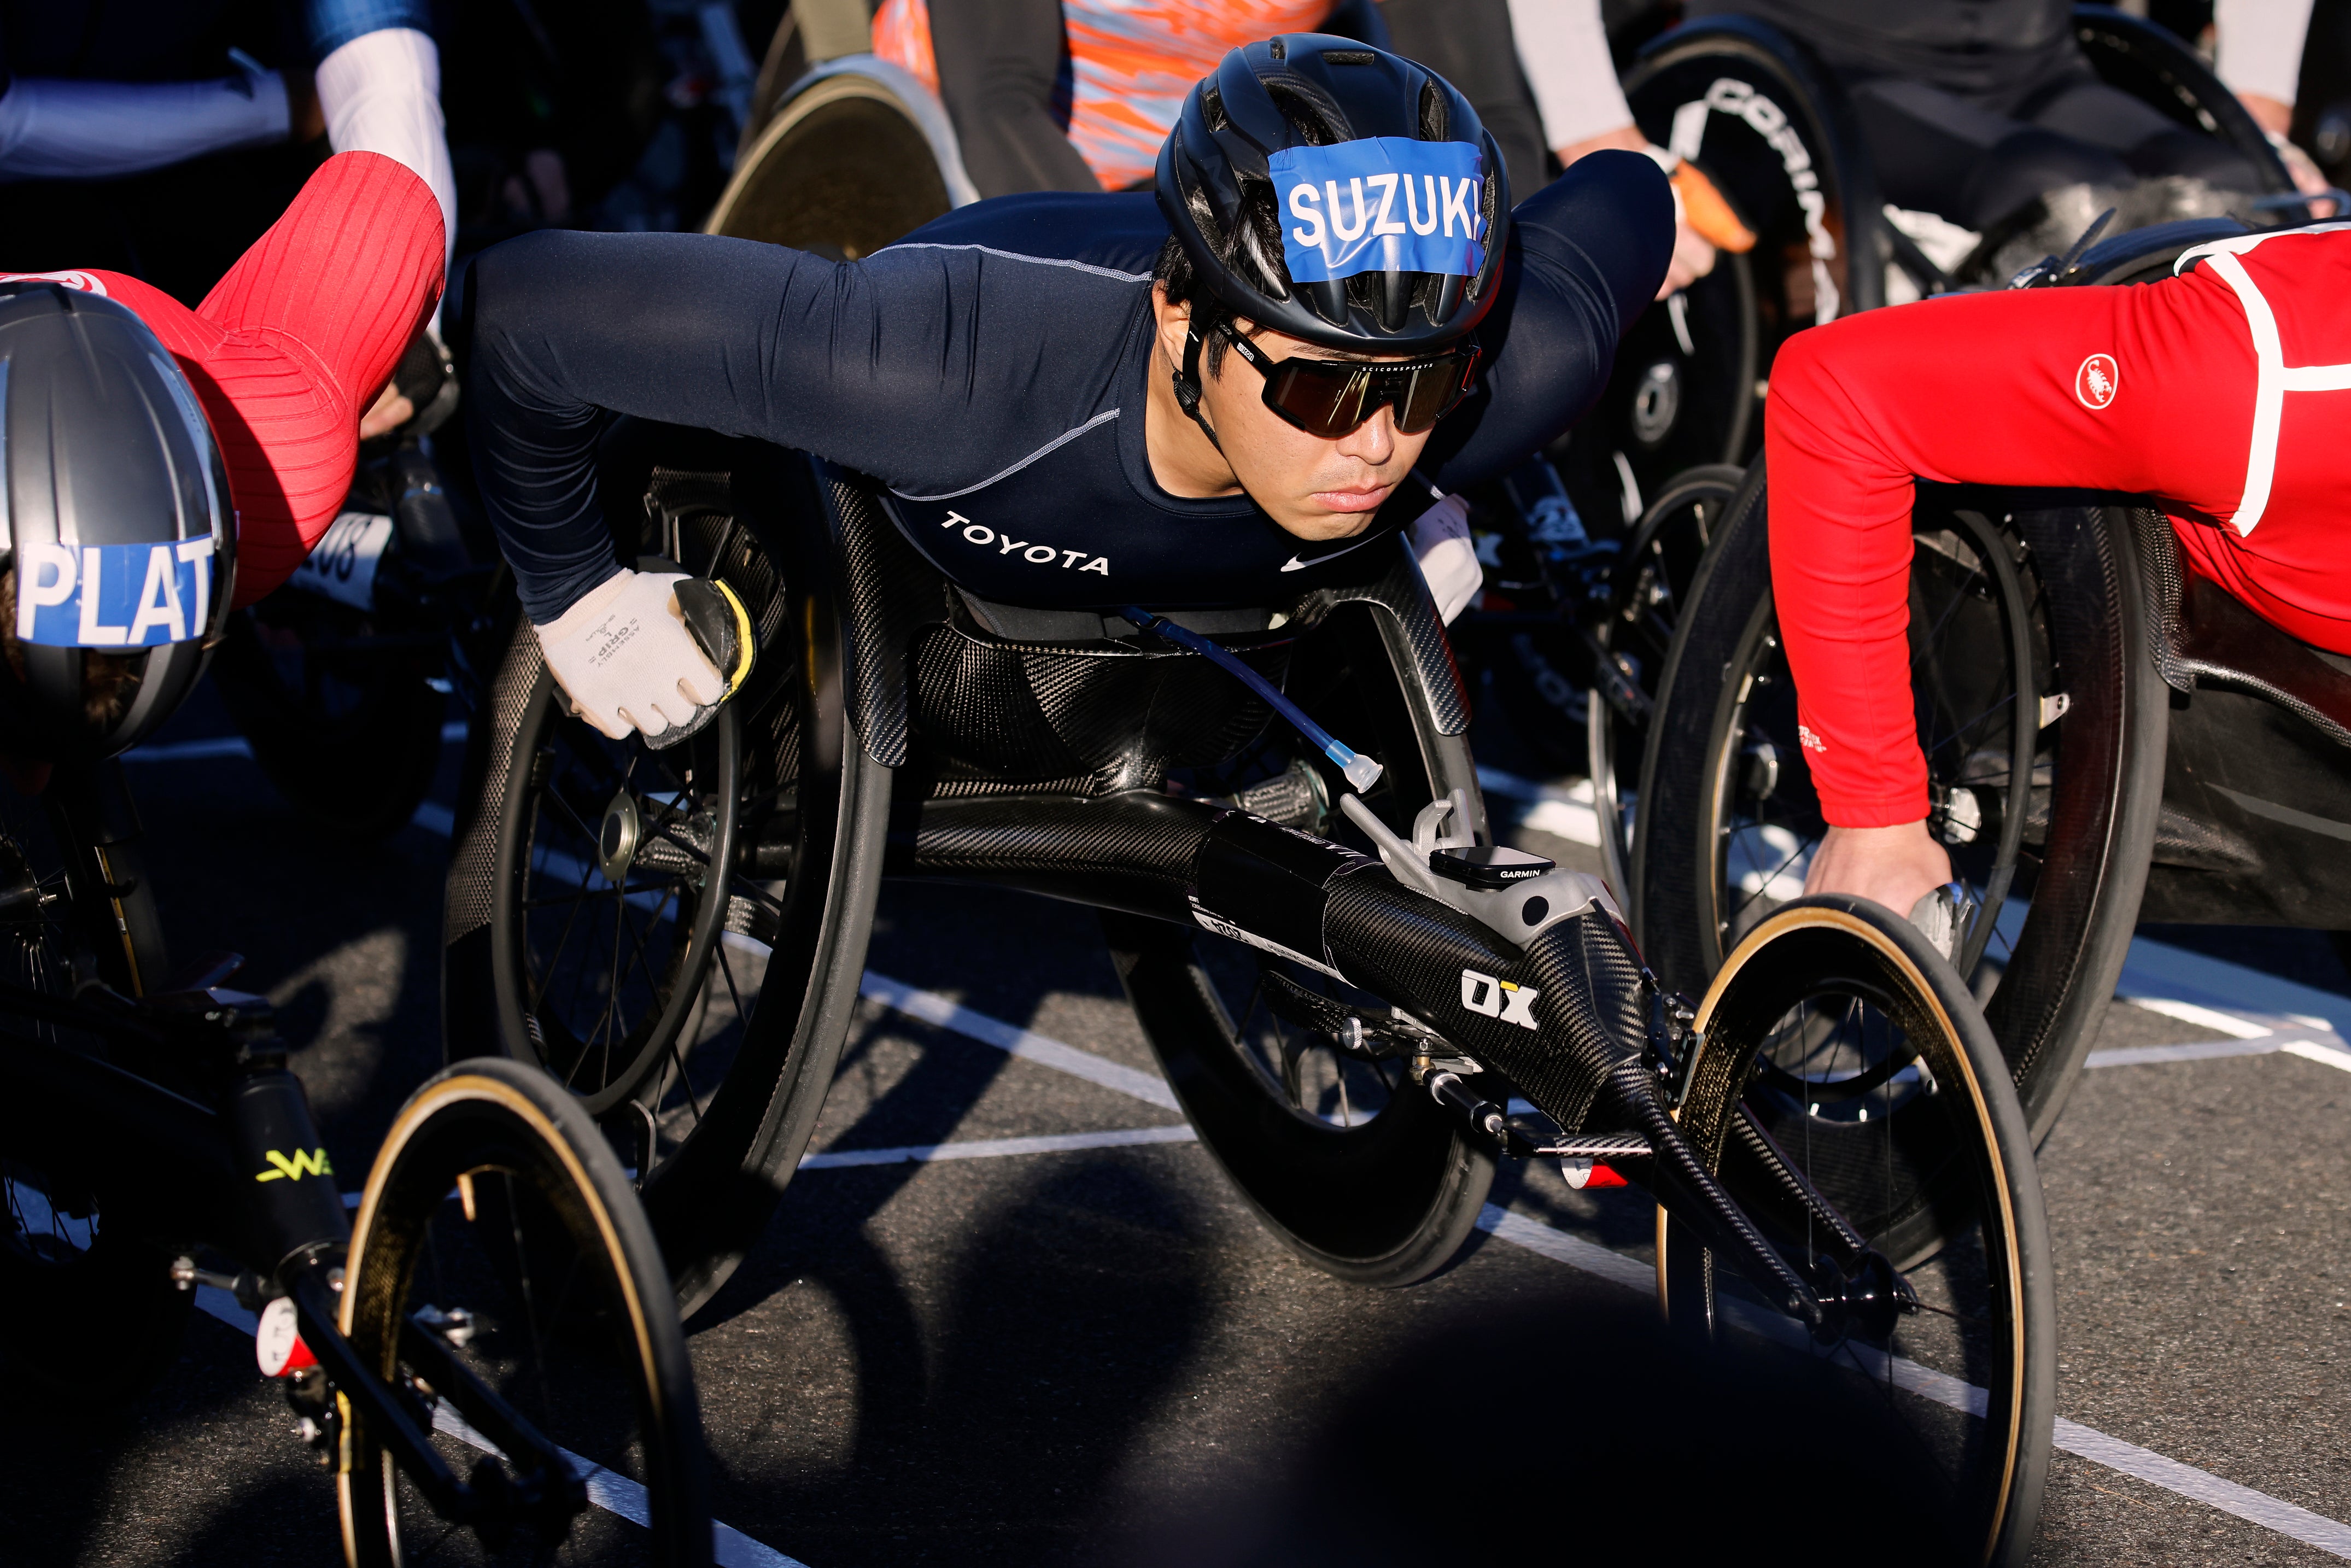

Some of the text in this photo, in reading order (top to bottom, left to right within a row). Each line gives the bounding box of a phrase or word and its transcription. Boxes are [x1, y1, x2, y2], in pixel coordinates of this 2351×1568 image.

[1289, 173, 1481, 247] SUZUKI
[1362, 363, 1433, 372] SCICONSPORTS
[941, 510, 1109, 576] TOYOTA
[17, 536, 215, 645] PLAT
[599, 627, 629, 656] GRIP
[1500, 869, 1540, 878] GARMIN
